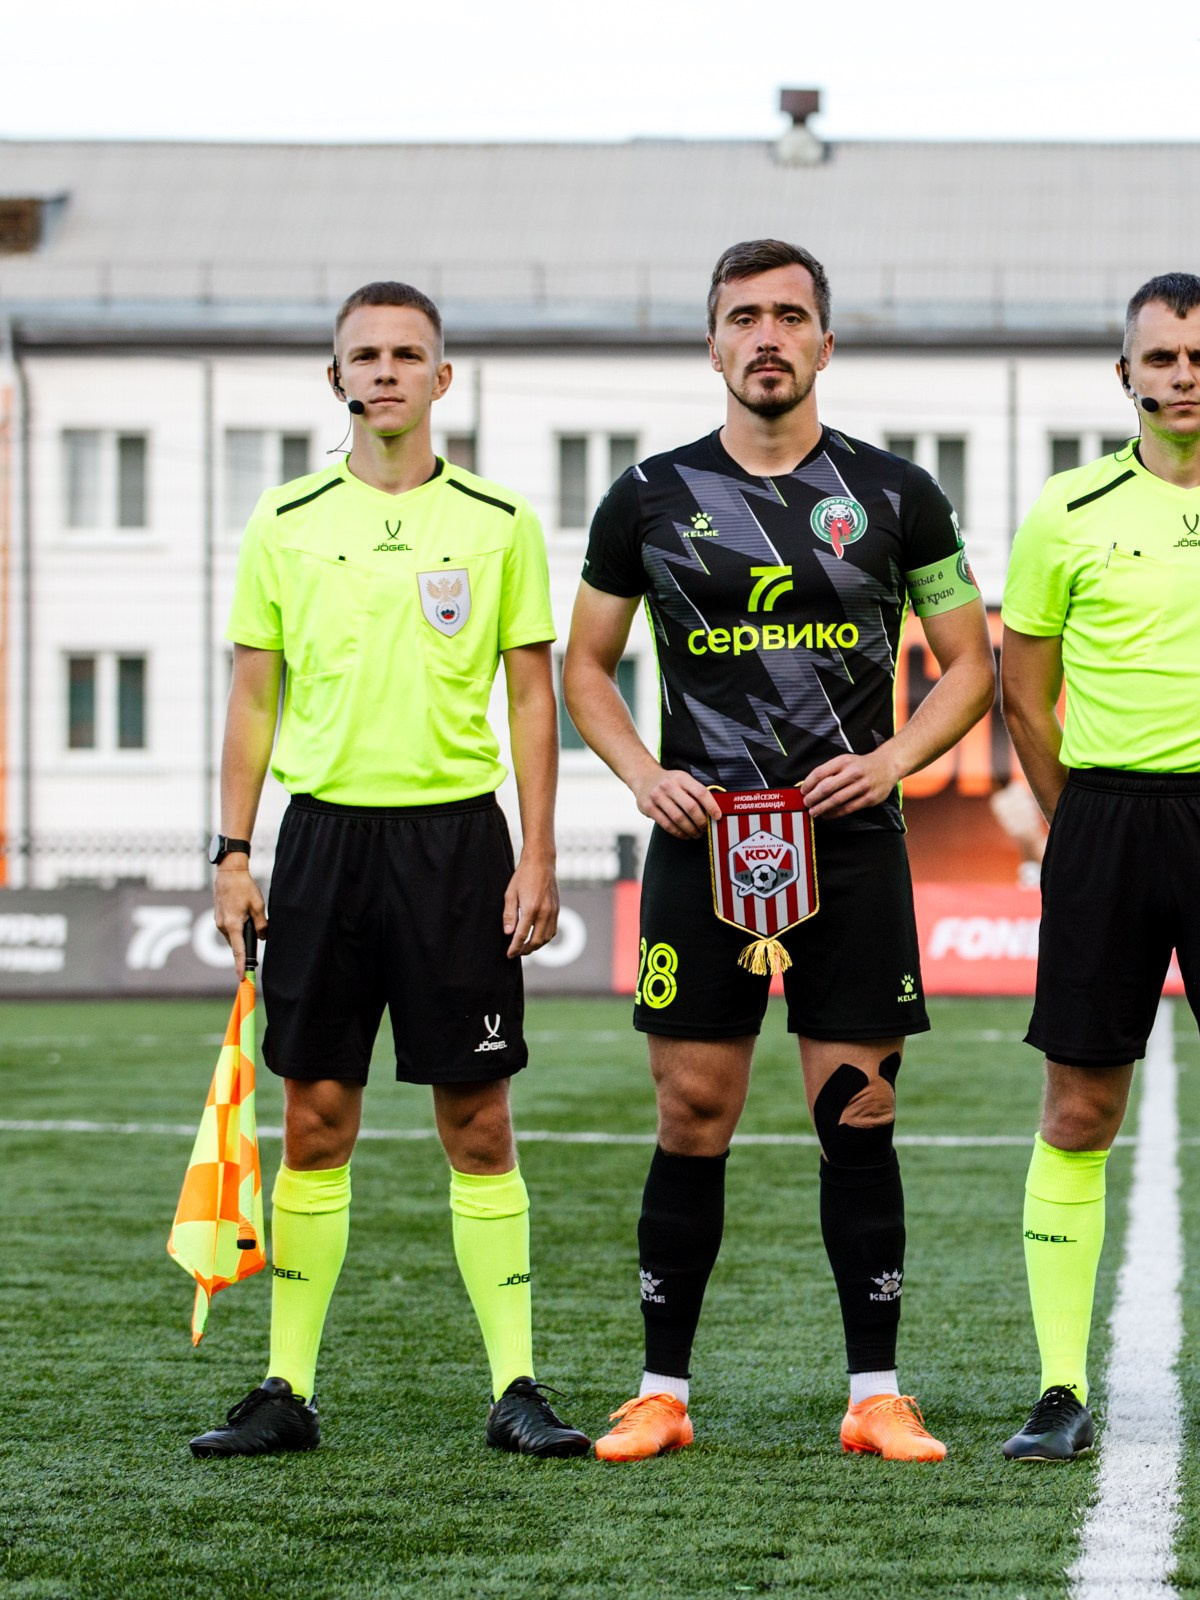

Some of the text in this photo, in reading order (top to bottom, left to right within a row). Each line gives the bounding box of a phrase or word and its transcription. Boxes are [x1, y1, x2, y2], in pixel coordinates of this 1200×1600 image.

[821, 499, 855, 509] ИРКУТСК
[683, 530, 719, 538] KELME
[373, 543, 412, 551] JÖGEL
[926, 587, 955, 605] краю
[688, 623, 859, 656] сервико
[745, 848, 782, 860] KDV
[635, 936, 679, 1010] 28
[474, 1040, 508, 1052] JÖGEL
[1024, 1229, 1078, 1243] JÖGEL
